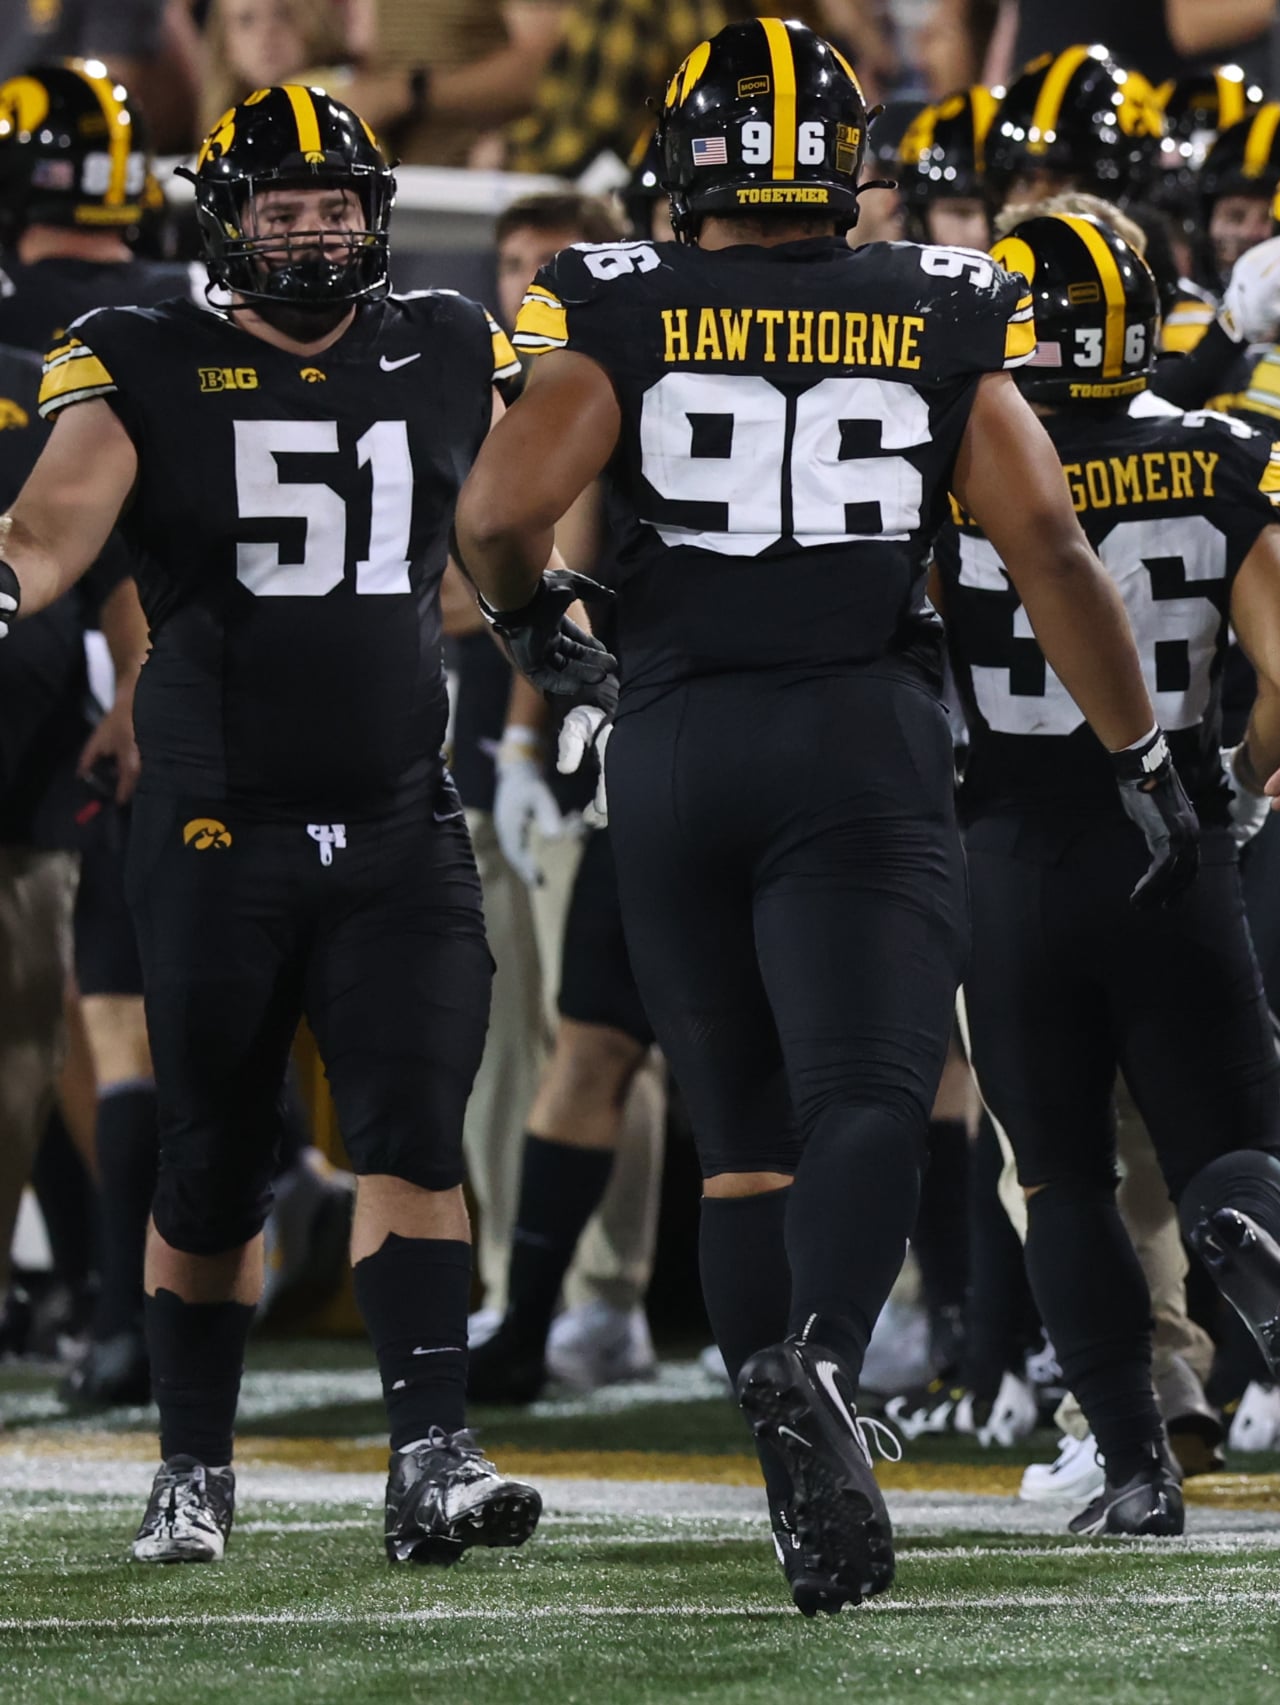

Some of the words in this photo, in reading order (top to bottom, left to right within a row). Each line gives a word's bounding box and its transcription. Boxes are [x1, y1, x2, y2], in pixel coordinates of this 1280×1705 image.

[741, 121, 825, 165] 96
[736, 188, 829, 204] TOGETHER
[660, 308, 925, 370] HAWTHORNE
[1074, 324, 1145, 368] 36
[639, 372, 934, 557] 96
[232, 419, 414, 596] 51
